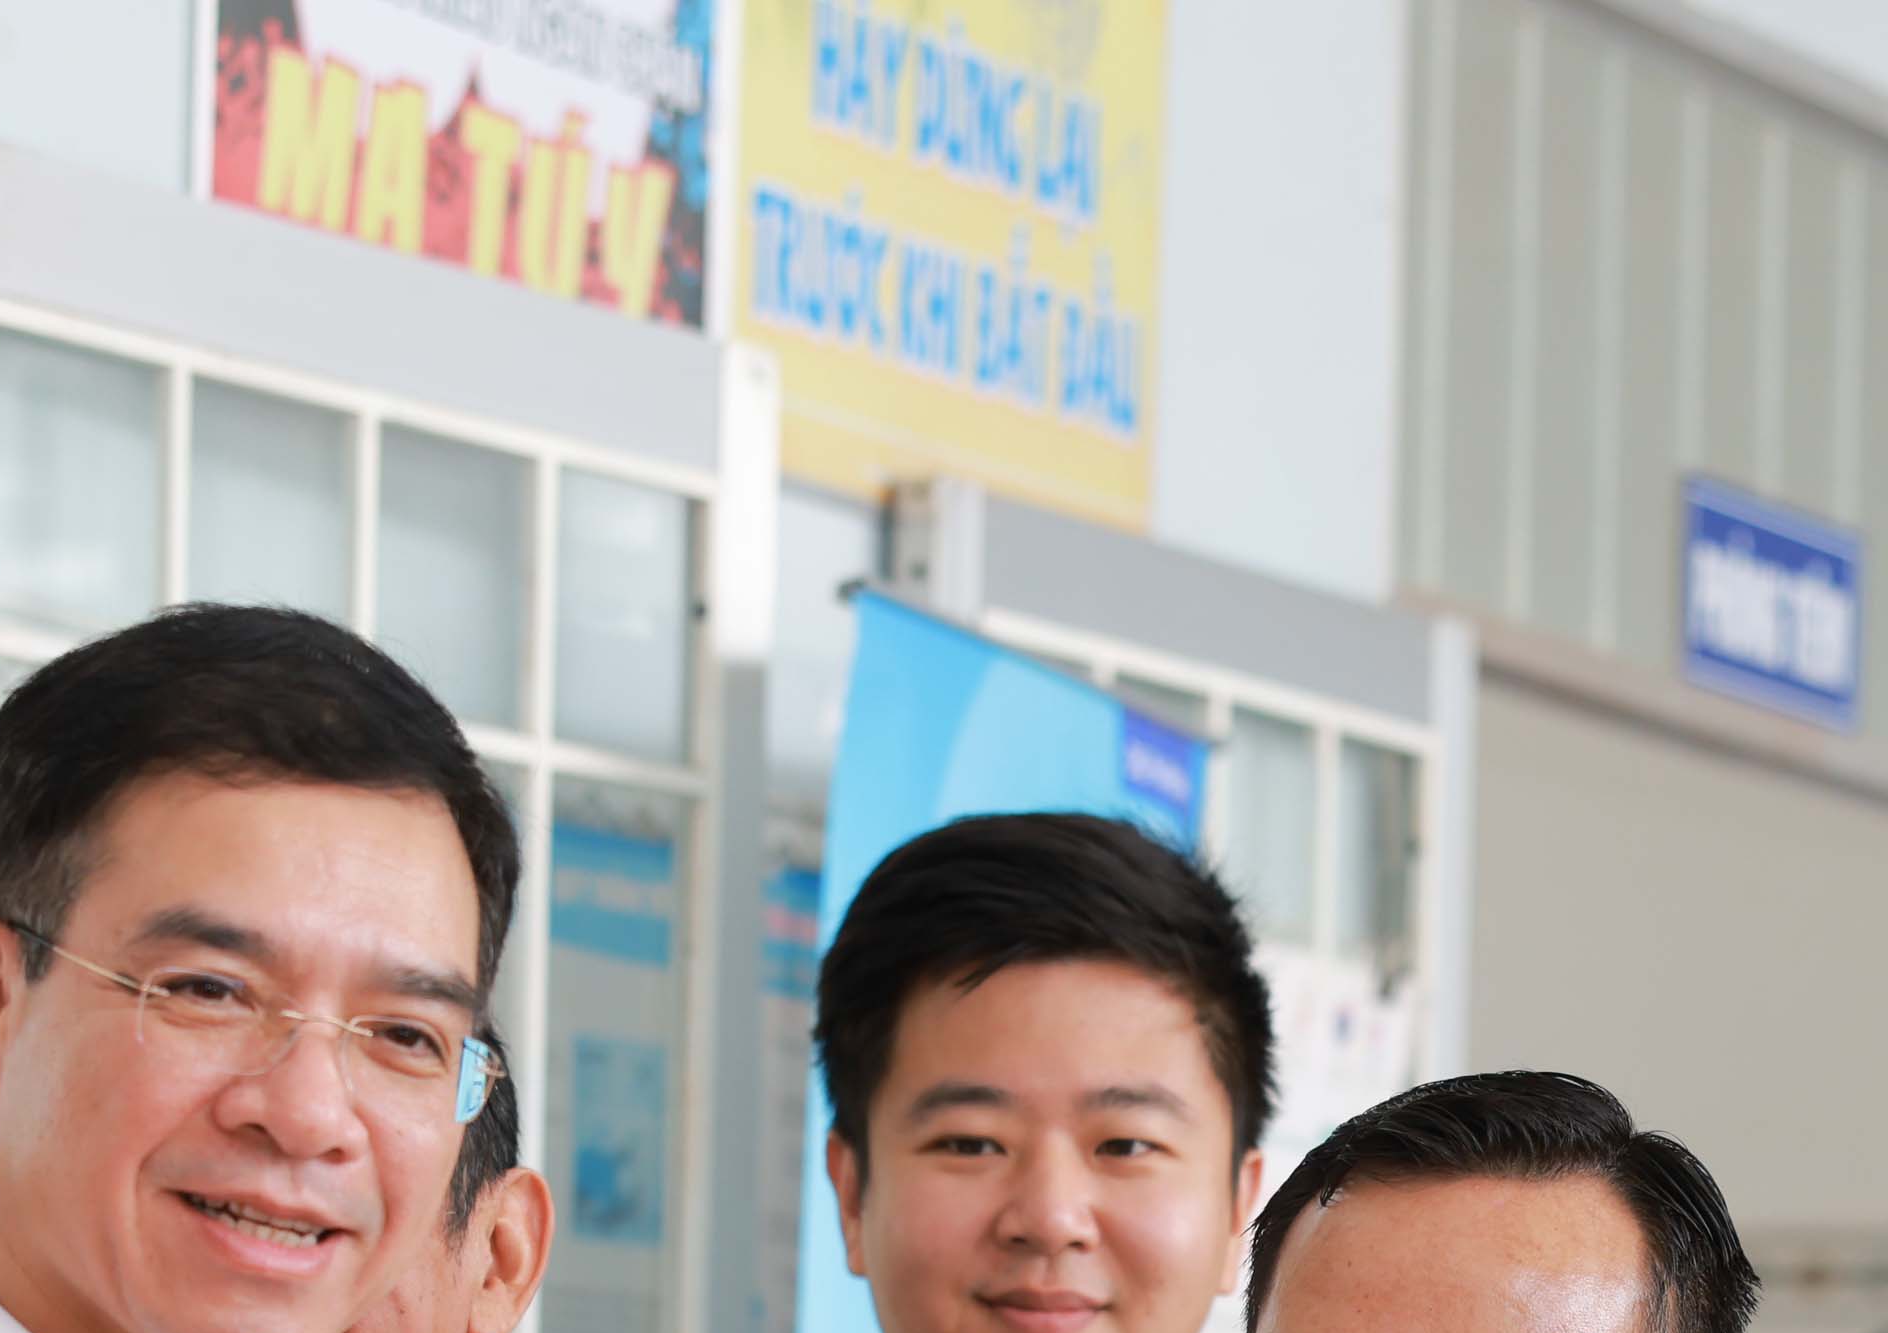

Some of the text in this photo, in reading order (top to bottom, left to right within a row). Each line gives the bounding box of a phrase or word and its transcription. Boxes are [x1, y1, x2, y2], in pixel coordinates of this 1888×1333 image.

[256, 42, 427, 256] MA
[458, 98, 677, 320] TÚY
[899, 242, 965, 376] KHI
